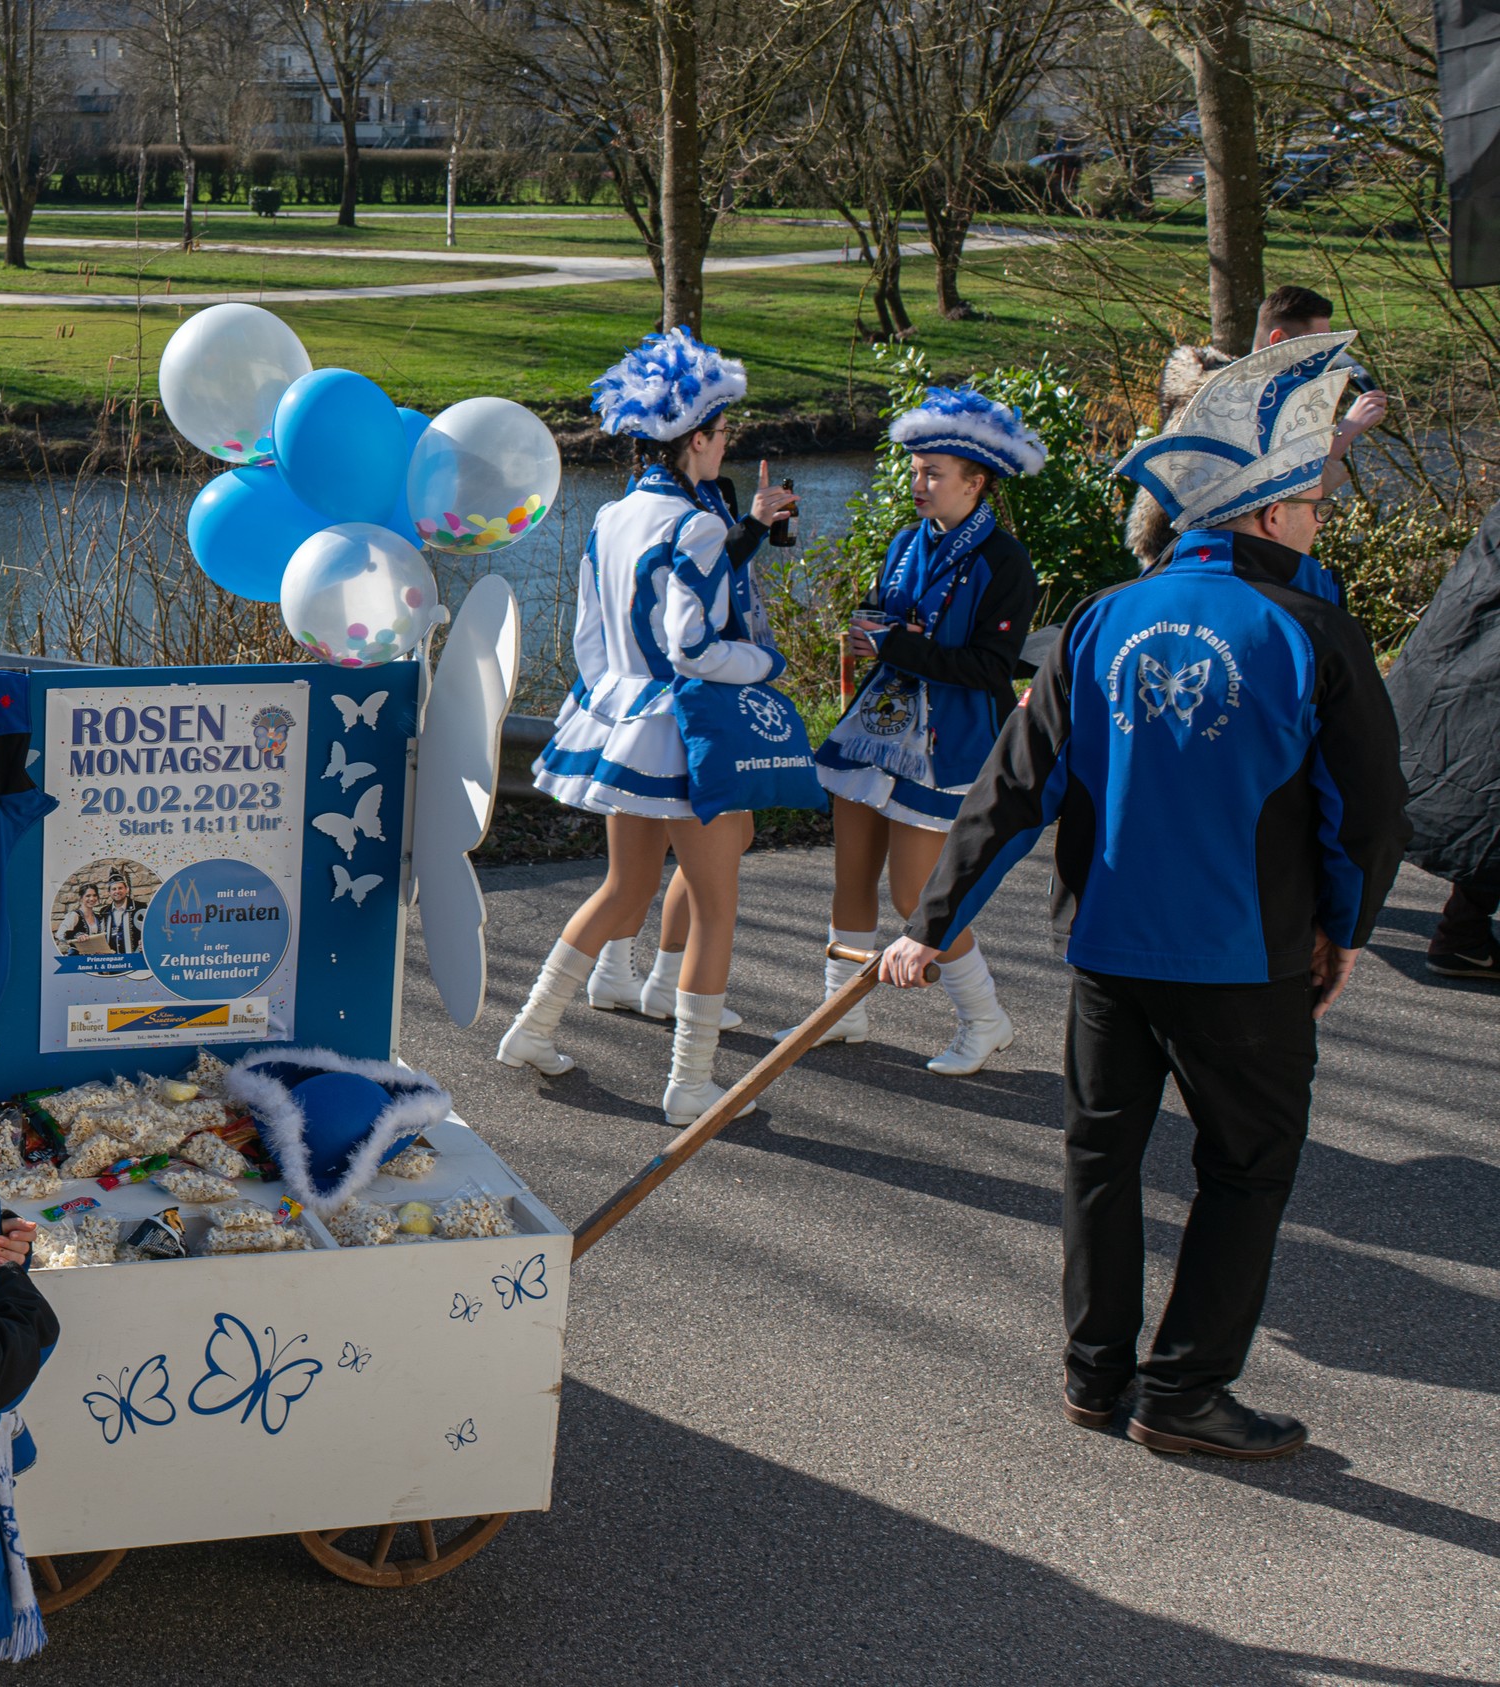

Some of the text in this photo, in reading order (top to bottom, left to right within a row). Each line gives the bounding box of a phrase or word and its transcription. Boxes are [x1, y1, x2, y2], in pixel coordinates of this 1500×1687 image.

[1194, 625, 1243, 708] Wallendorf
[71, 704, 227, 747] ROSEN
[259, 706, 297, 727] Wallendorf
[1112, 711, 1135, 735] KV
[1201, 714, 1229, 741] e.V.
[69, 745, 286, 777] MONTAGSZUG
[734, 756, 771, 773] Prinz
[772, 755, 807, 768] Daniel
[80, 781, 283, 816] 20.02.2023
[118, 813, 283, 836] Start: 14:11 Uhr
[216, 887, 257, 899] mit den
[203, 943, 230, 951] in der
[160, 951, 271, 967] Zehntscheune
[171, 965, 260, 981] in Wallendorf
[70, 1021, 105, 1033] Bitburger
[233, 1014, 267, 1025] Bitburger
